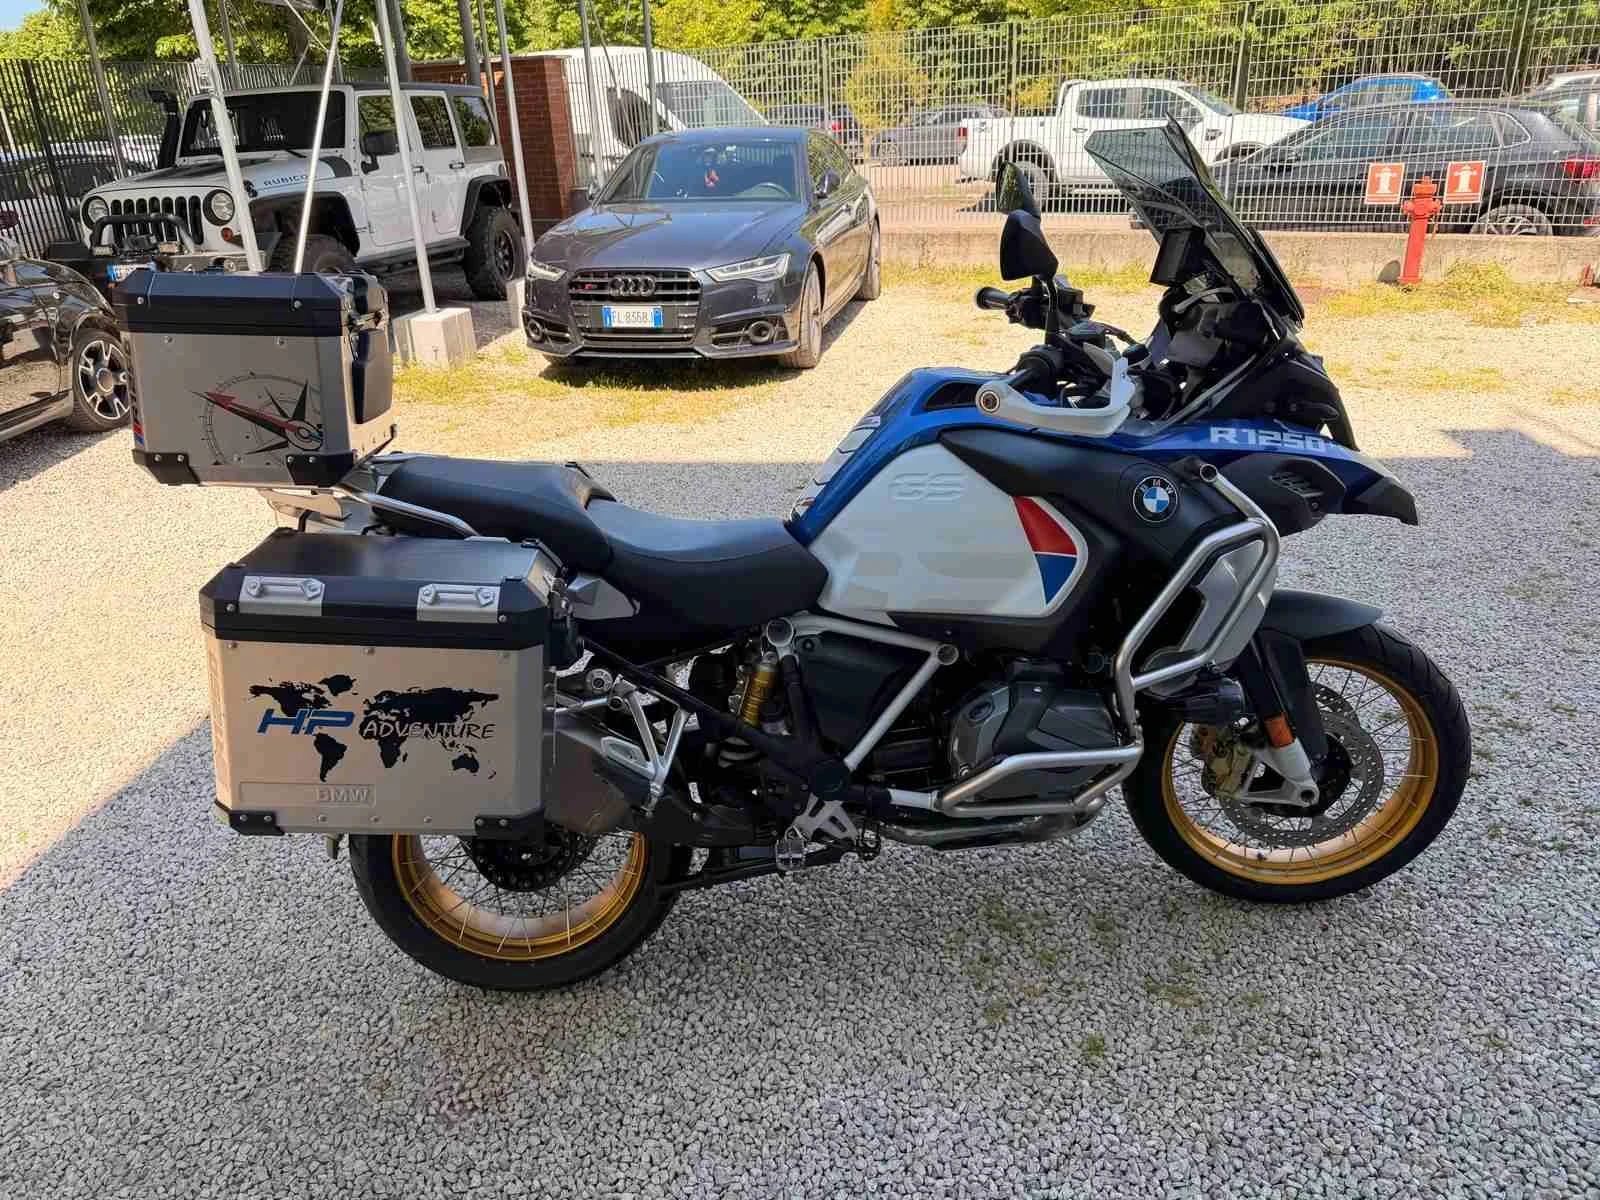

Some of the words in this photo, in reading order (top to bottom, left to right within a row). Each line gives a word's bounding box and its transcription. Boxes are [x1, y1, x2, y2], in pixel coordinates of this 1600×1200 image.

[263, 174, 314, 187] RUBICO
[888, 471, 966, 503] GS
[256, 707, 355, 735] HP
[362, 720, 497, 739] ADVENTURE
[317, 786, 369, 802] BMW
